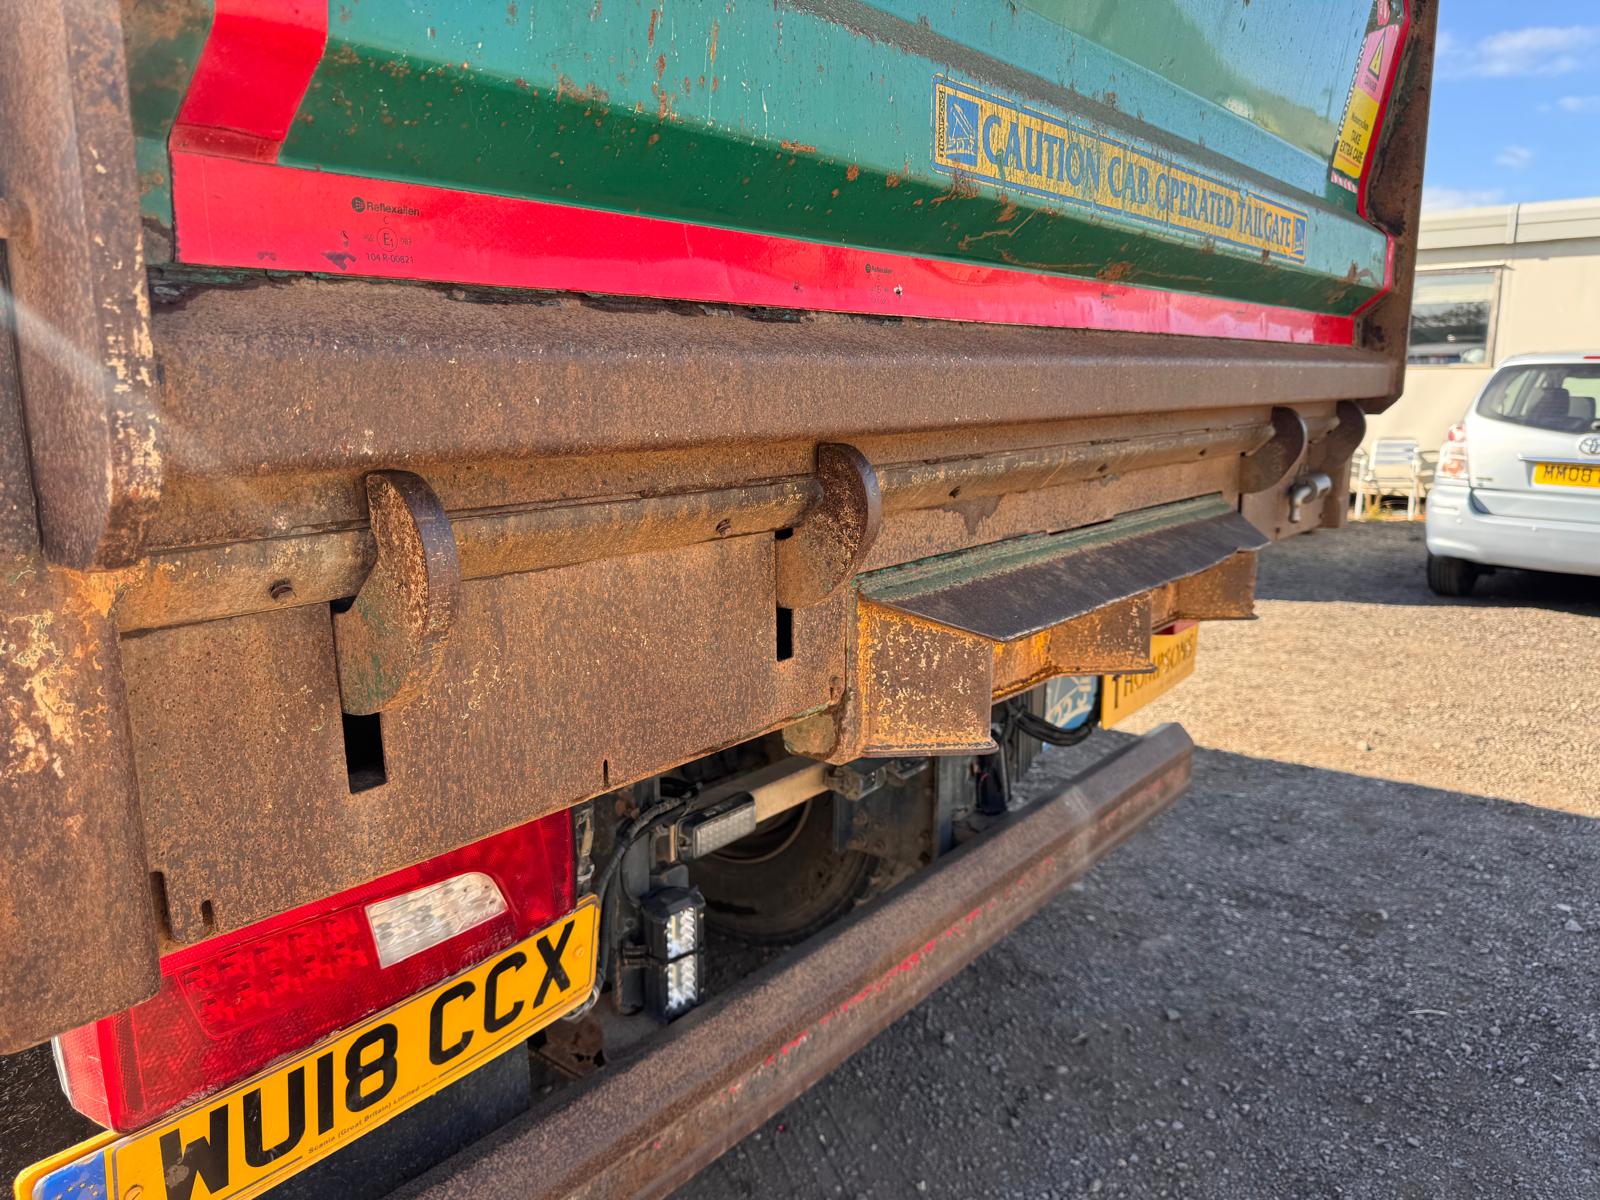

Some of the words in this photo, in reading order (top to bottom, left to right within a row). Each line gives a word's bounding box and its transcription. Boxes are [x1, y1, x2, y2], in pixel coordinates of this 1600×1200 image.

[1340, 140, 1353, 156] EXTRA
[1352, 148, 1364, 164] CARE
[1351, 129, 1362, 145] TAKE
[982, 115, 1100, 192] CAUTION
[1107, 156, 1148, 206] CAB
[1156, 174, 1234, 229] OPERATED
[1238, 203, 1292, 248] TAILGATE
[1543, 464, 1592, 483] MM08
[159, 1023, 398, 1200] WU18
[428, 920, 576, 1066] CCX
[308, 1135, 336, 1154] Scania
[338, 1120, 362, 1139] (Great
[364, 1102, 392, 1123] Britain)
[393, 1085, 421, 1105] Limited
